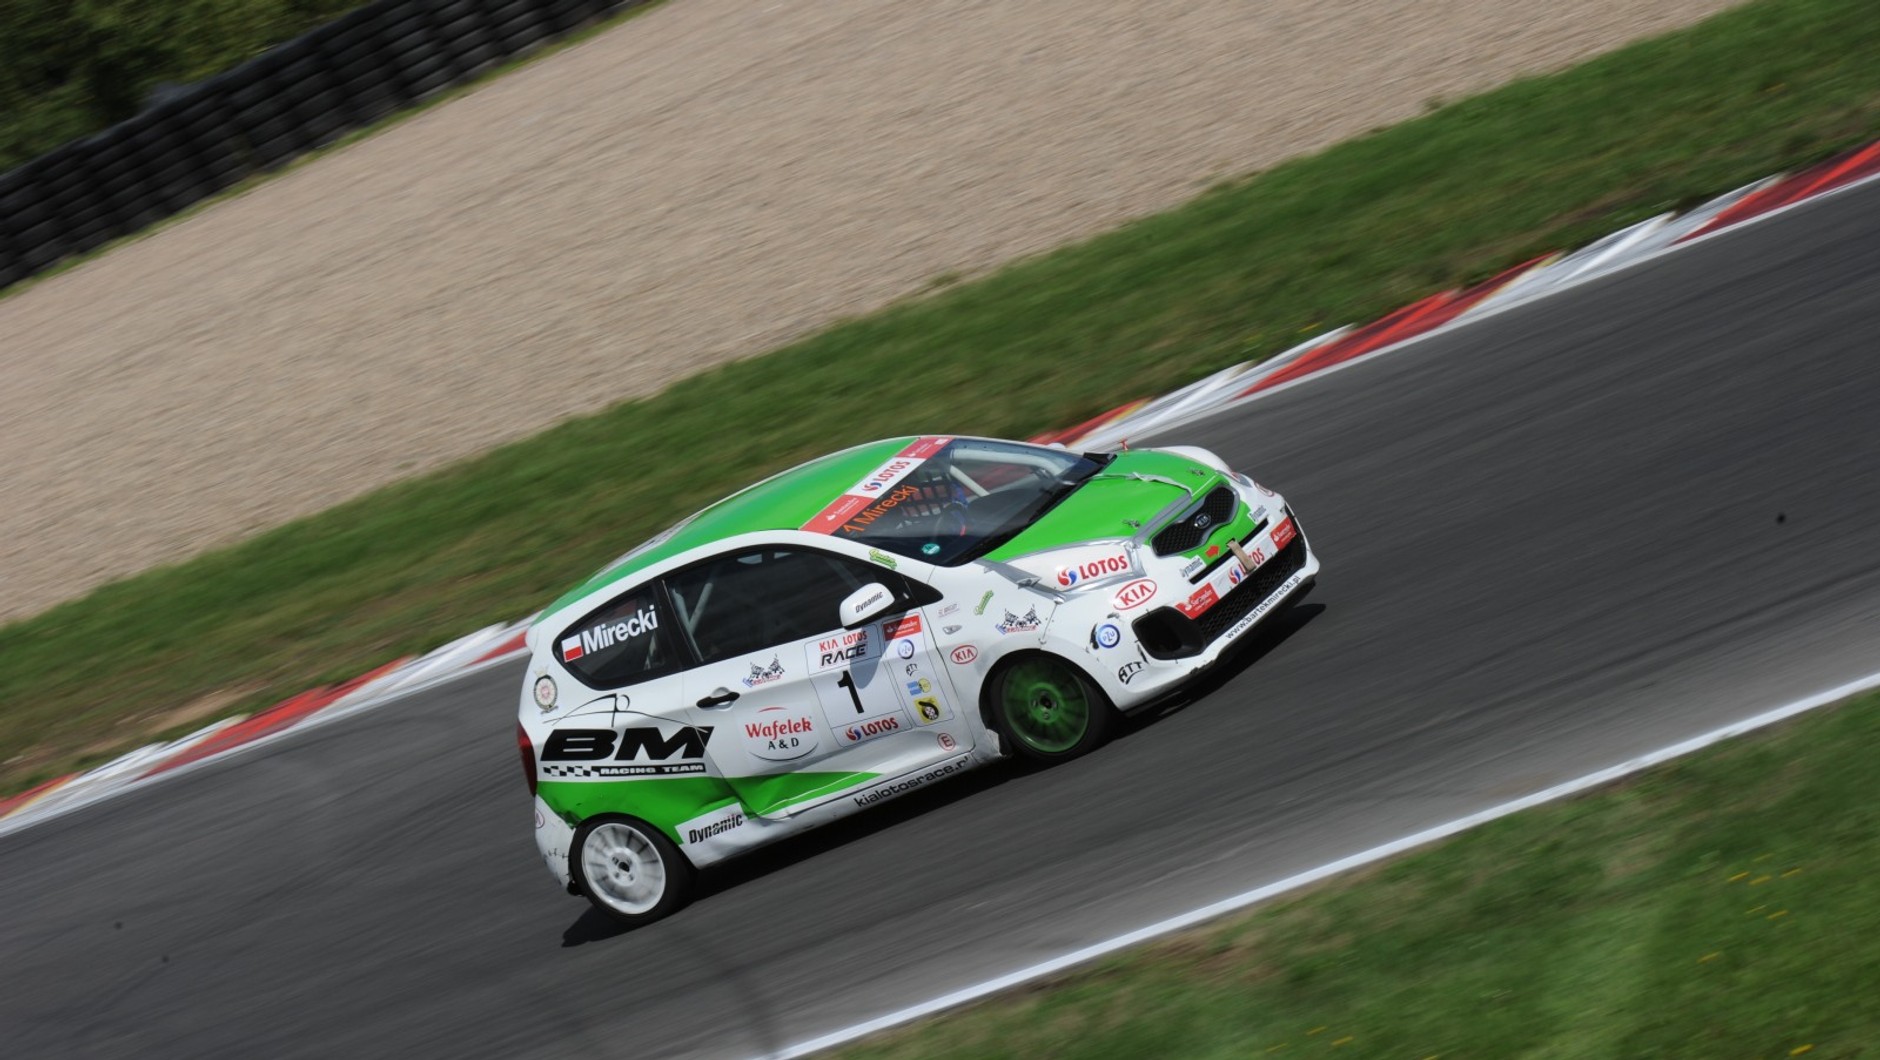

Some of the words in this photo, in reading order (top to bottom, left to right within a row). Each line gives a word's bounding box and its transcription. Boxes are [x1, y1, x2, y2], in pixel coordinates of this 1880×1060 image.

[874, 461, 911, 482] LOTOS
[853, 484, 919, 525] Mirecki
[1079, 555, 1128, 579] LOTOS
[1225, 575, 1301, 639] www.bartekmirecki.pl
[582, 604, 659, 655] Mirecki
[819, 638, 839, 652] KIA
[843, 630, 868, 645] LOTOS
[821, 644, 866, 667] RACE
[954, 648, 974, 661] KIA
[837, 670, 865, 714] 1
[745, 717, 812, 740] Wafelek
[861, 717, 899, 737] LOTOS
[540, 726, 715, 761] BM
[768, 741, 776, 750] A
[779, 739, 788, 749] &
[791, 737, 799, 747] D
[600, 765, 657, 775] RACING
[662, 763, 705, 773] TEAM
[689, 814, 743, 844] Dynamic
